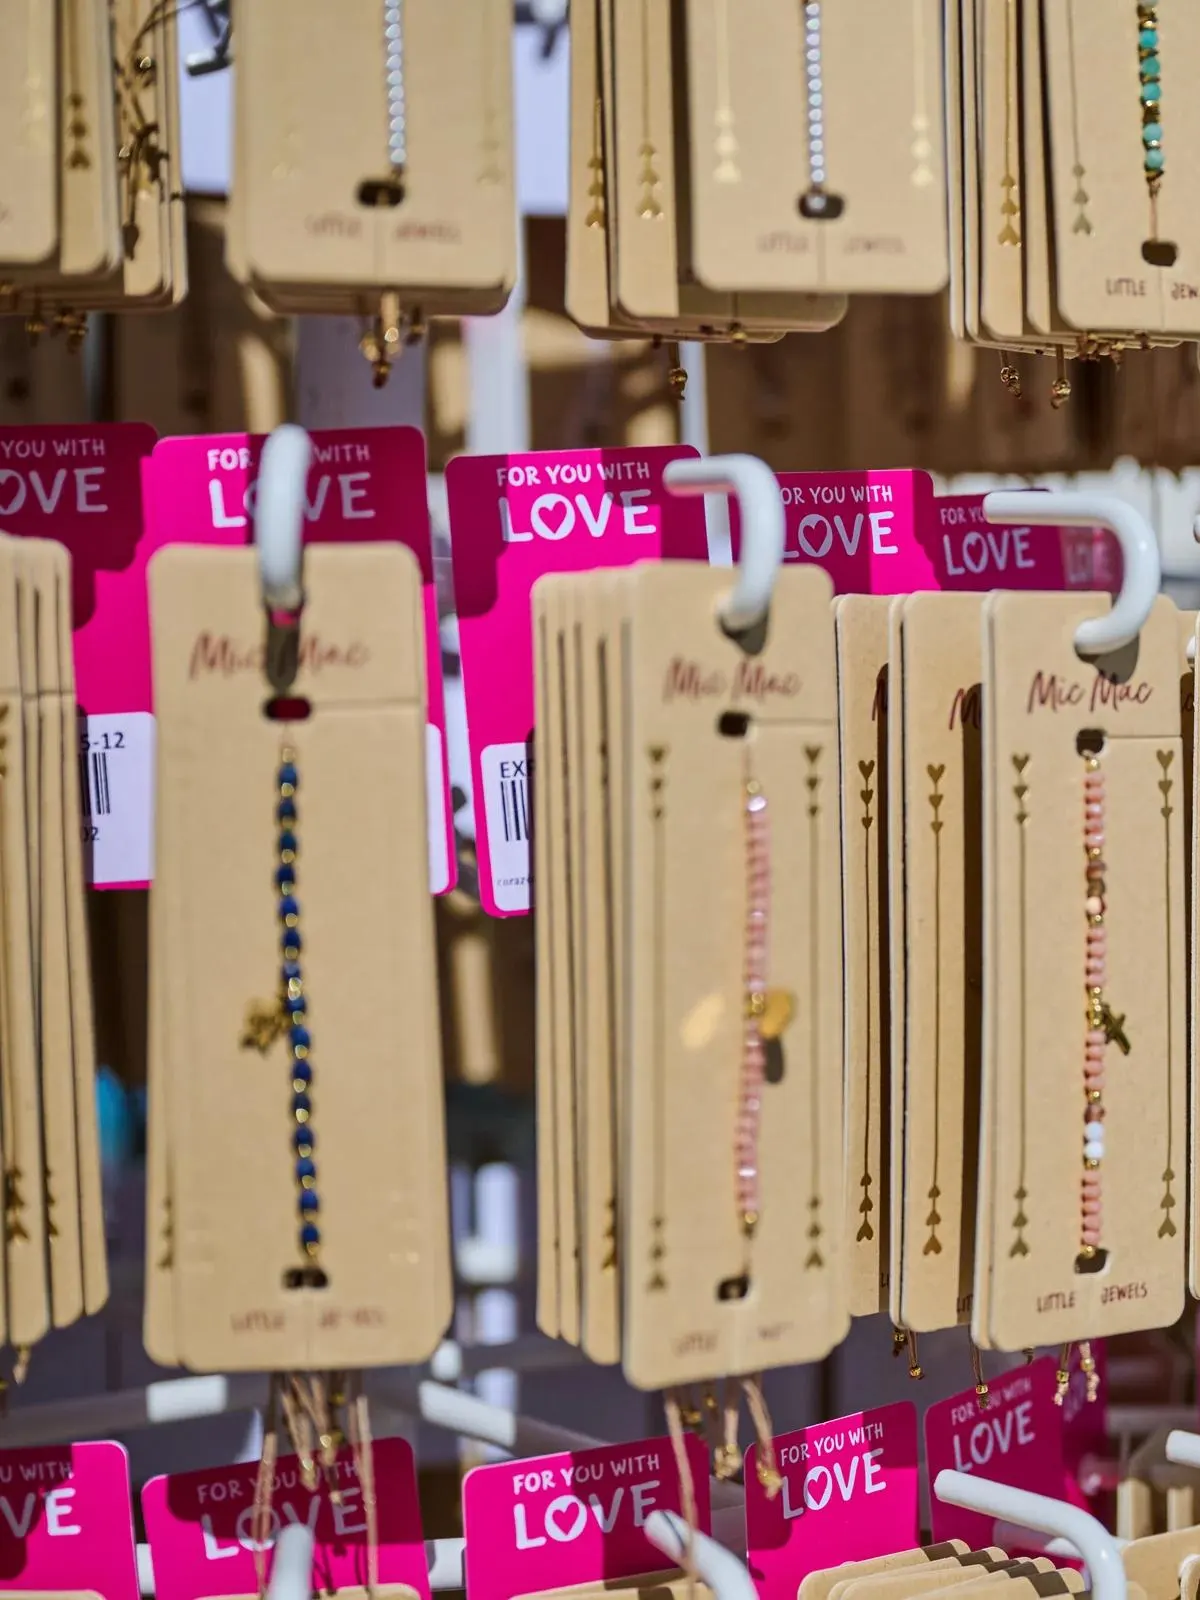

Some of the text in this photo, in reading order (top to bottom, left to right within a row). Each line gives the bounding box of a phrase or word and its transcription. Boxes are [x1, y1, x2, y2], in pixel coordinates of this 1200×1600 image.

[1, 437, 105, 459] YOU WITH
[207, 448, 253, 471] FOR
[0, 466, 108, 515] OVE
[496, 462, 650, 487] FOR YOU WITH
[779, 485, 893, 505] OR YOU WITH
[208, 471, 376, 529] LVE
[498, 489, 657, 543] LOVE
[940, 507, 967, 525] FOR
[943, 527, 1036, 576] LOVE
[1027, 670, 1086, 714] Mic
[1089, 669, 1154, 712] Mac
[1037, 1281, 1148, 1313] LITTLE JEWELS
[952, 1401, 975, 1426] FOR
[780, 1421, 884, 1467] FOR YOU WITH
[953, 1400, 1036, 1473] LOVE
[19, 1461, 75, 1481] WITH
[197, 1481, 244, 1504] FOR
[512, 1453, 660, 1496] FOR YOU WITH
[781, 1447, 887, 1520] LOVE
[202, 1487, 369, 1560] LOVE
[513, 1479, 661, 1550] LOVE
